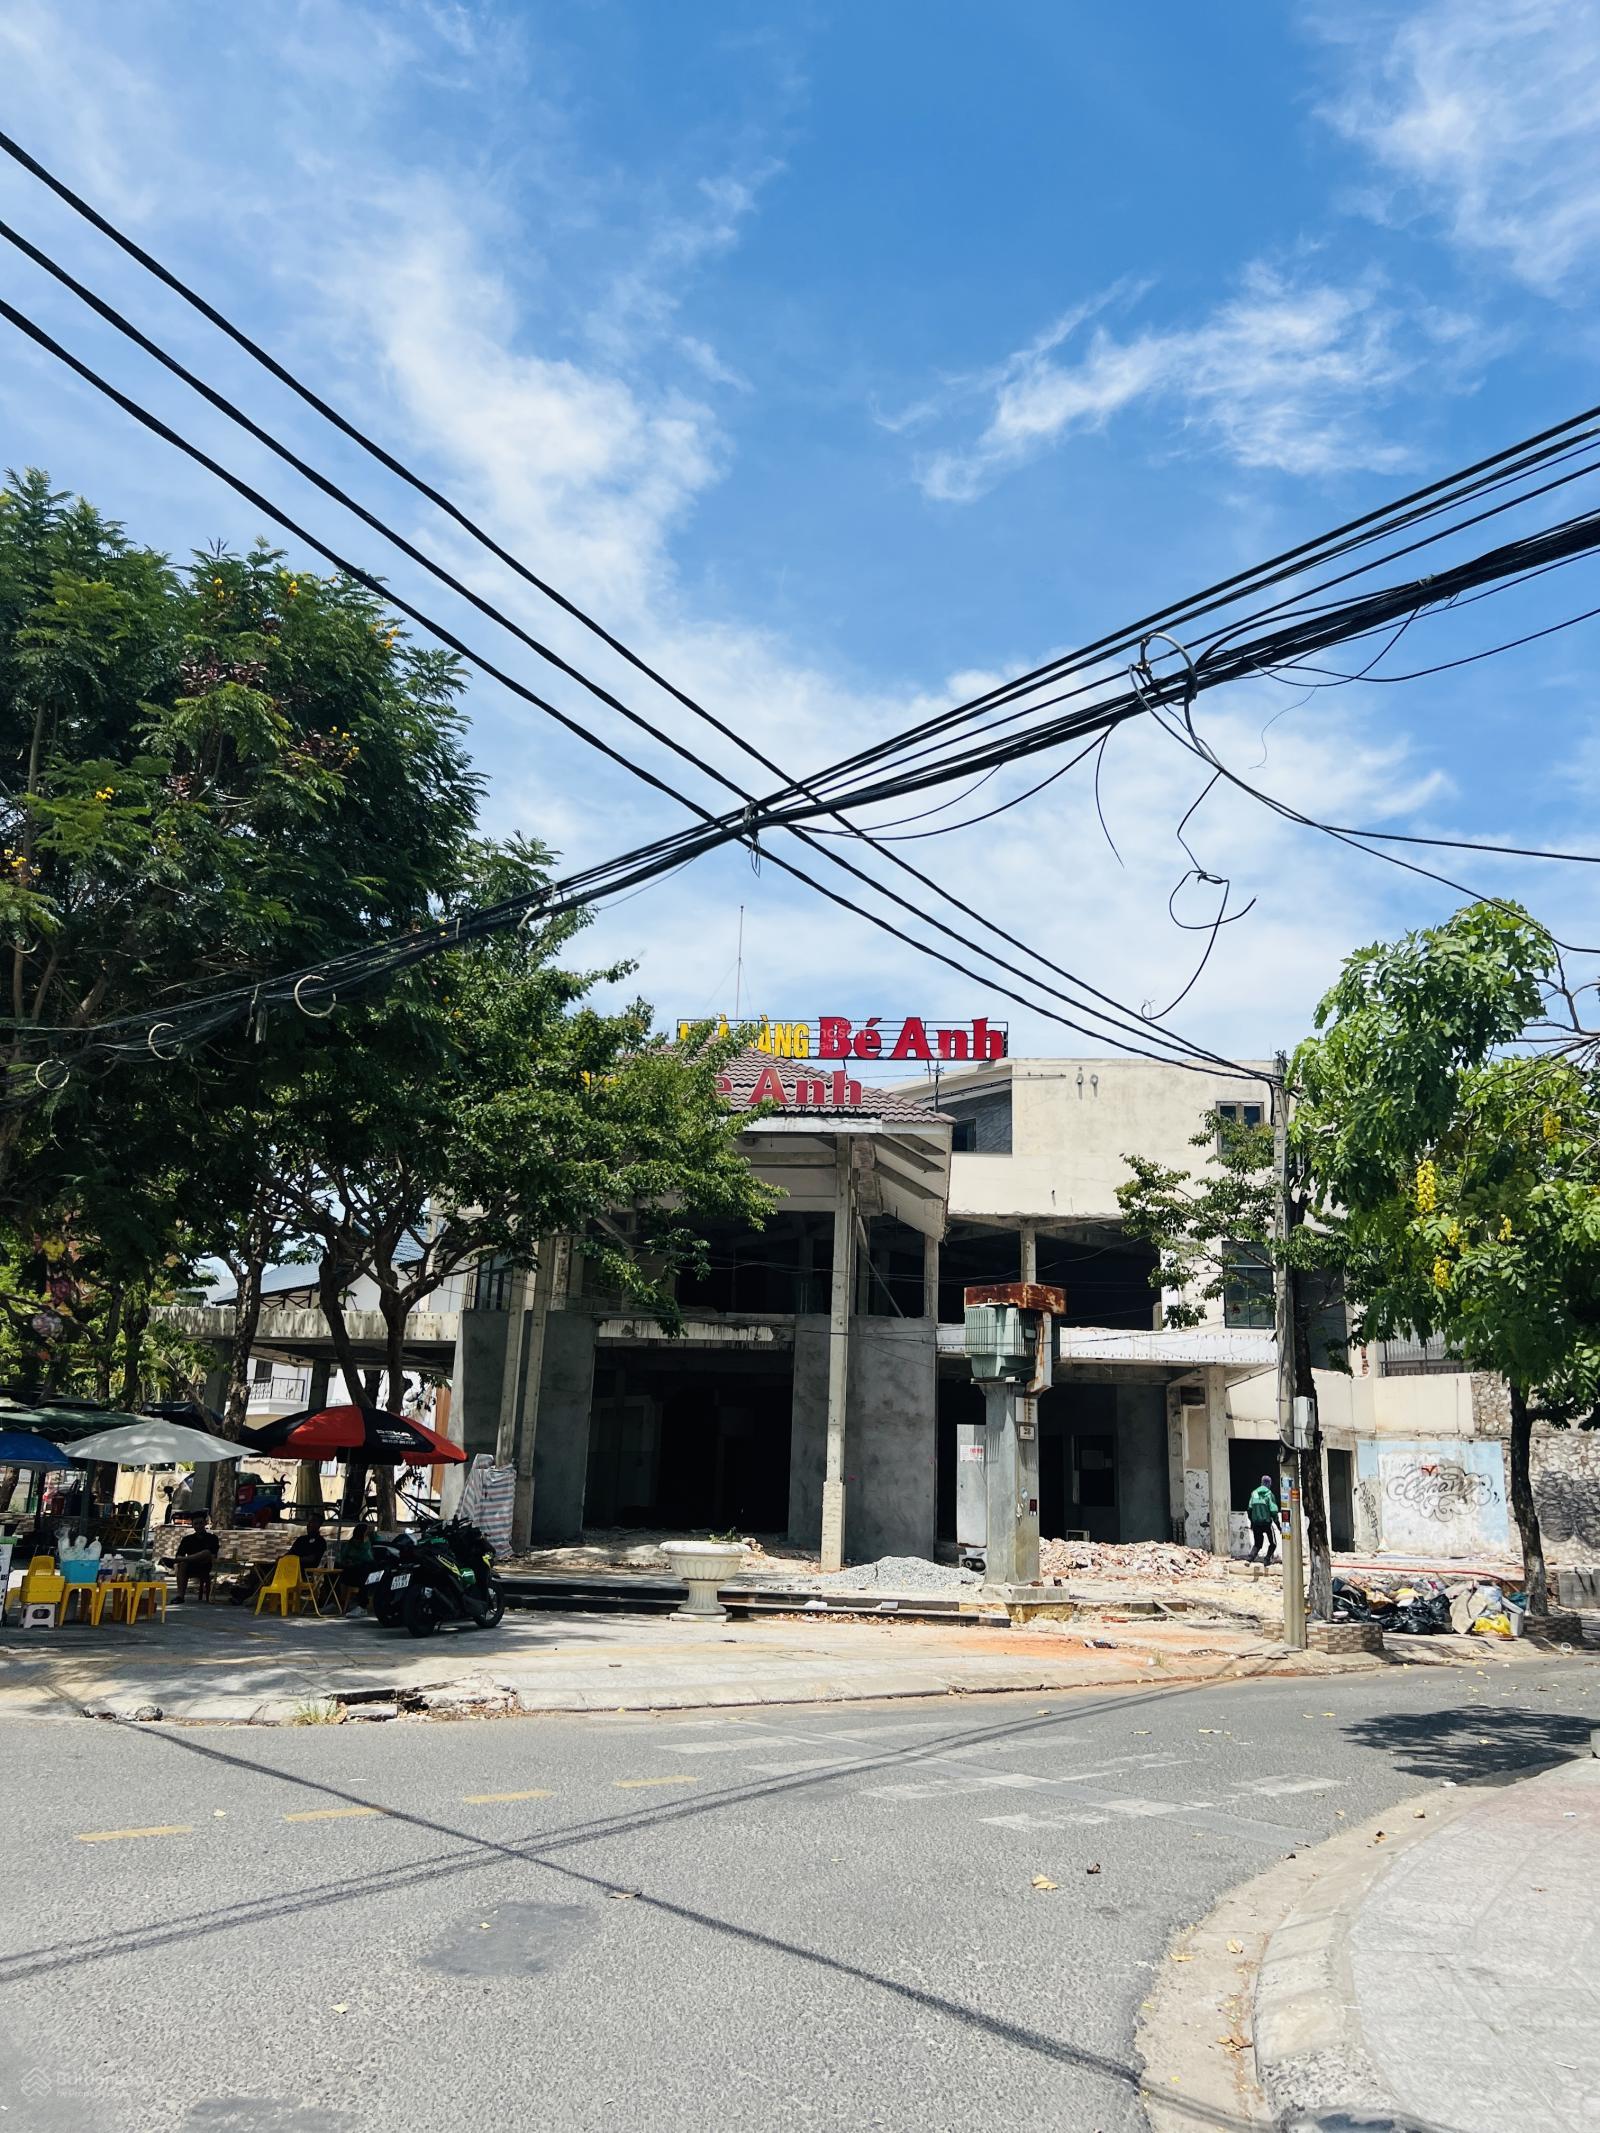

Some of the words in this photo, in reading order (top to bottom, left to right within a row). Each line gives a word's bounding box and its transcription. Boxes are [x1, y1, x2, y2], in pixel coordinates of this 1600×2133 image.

[818, 1016, 883, 1060] Bé
[889, 1016, 1007, 1060] Anh
[747, 1067, 862, 1105] Anh
